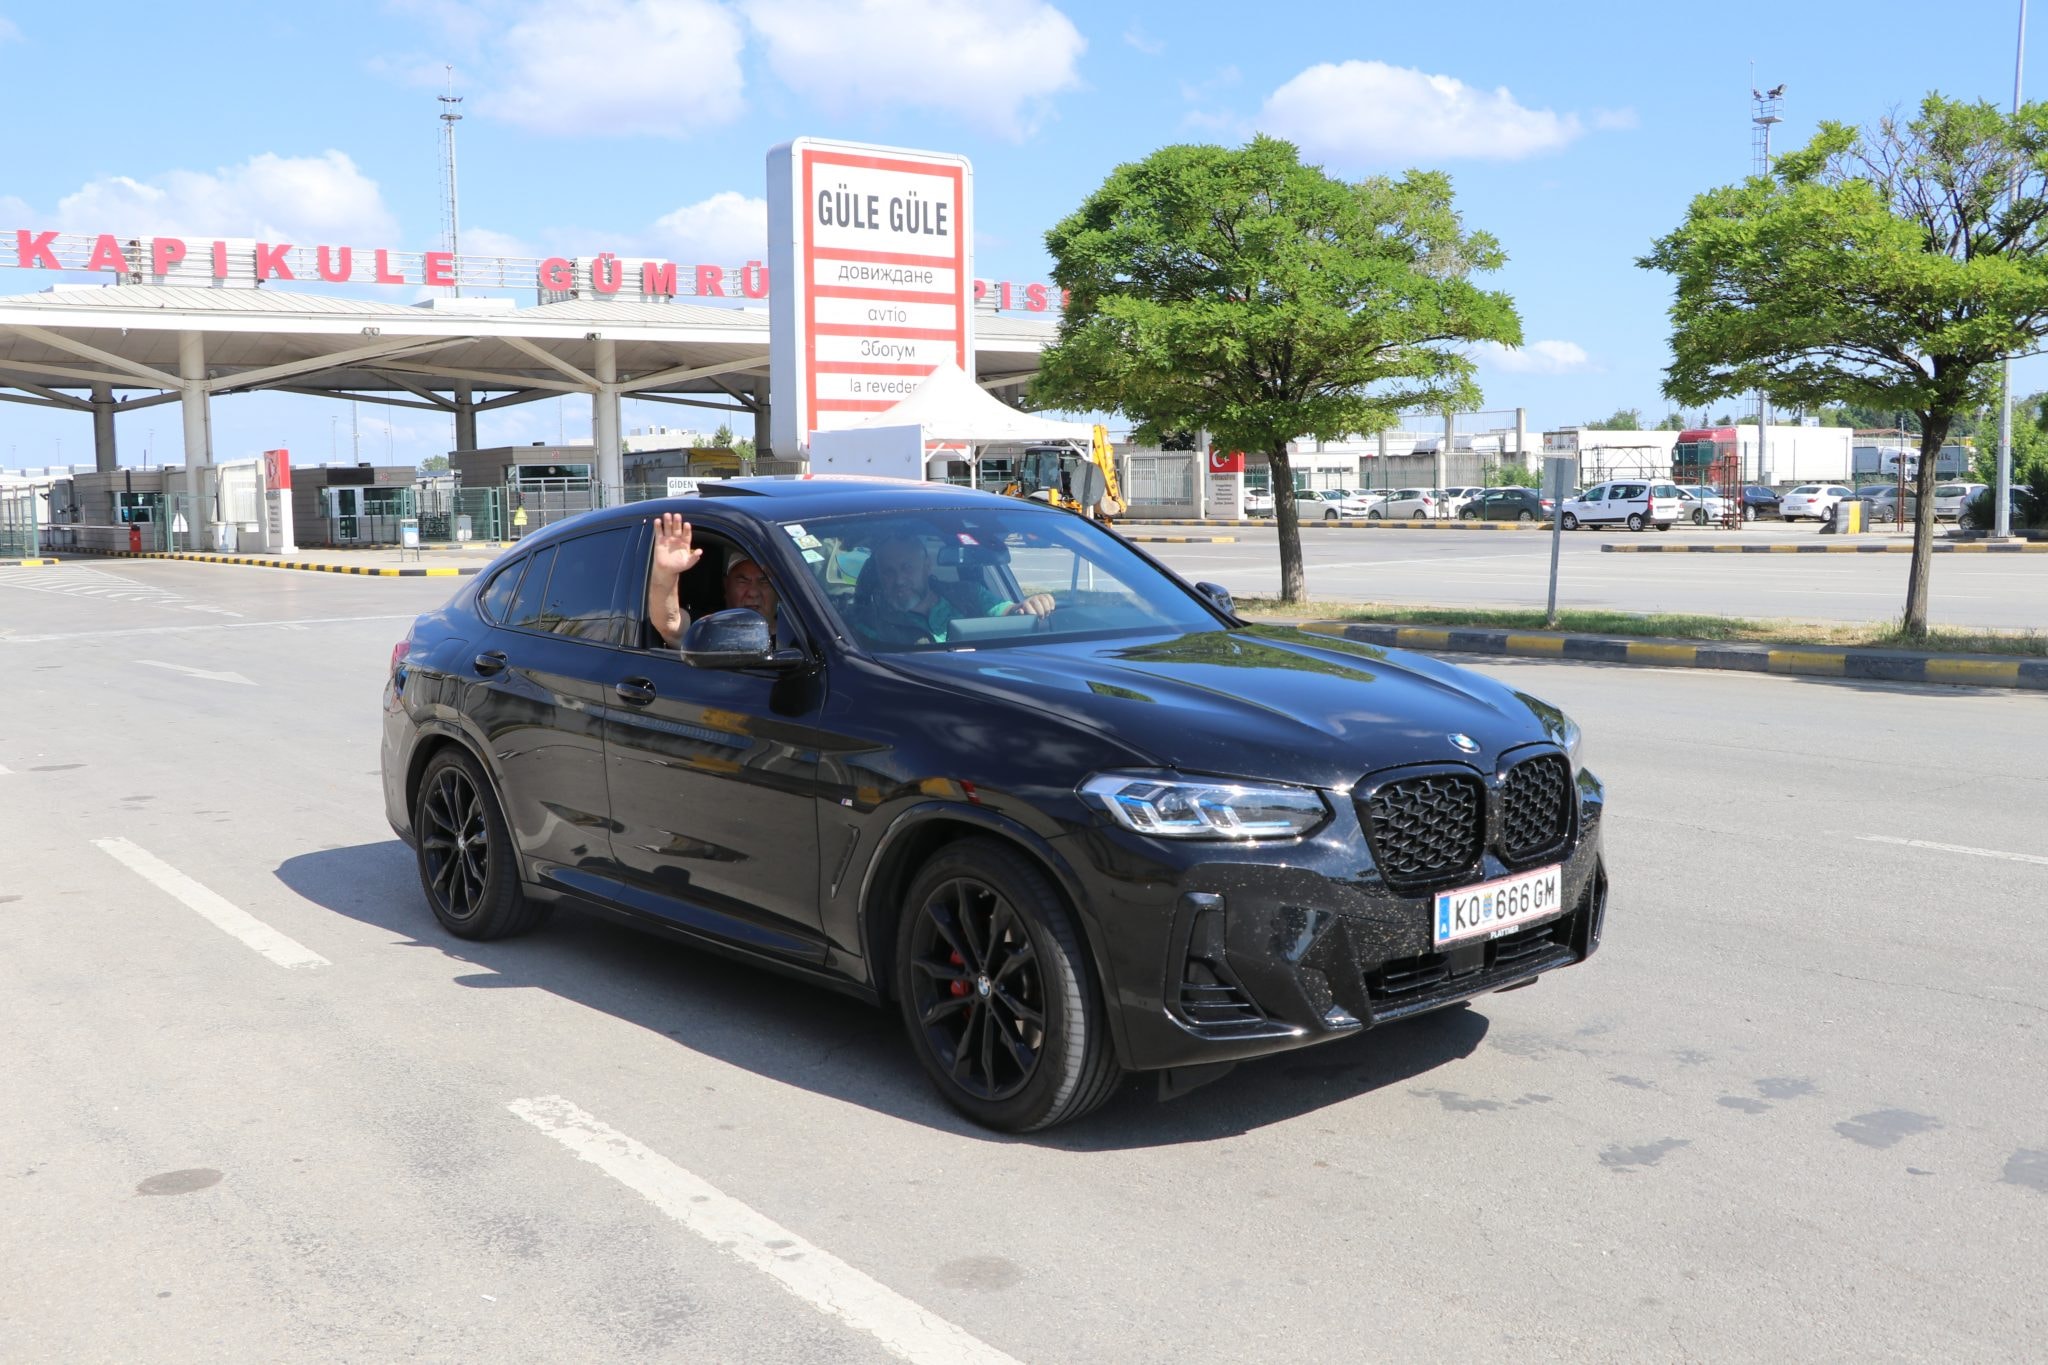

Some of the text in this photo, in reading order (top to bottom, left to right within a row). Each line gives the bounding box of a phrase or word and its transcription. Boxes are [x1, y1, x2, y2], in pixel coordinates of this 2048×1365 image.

[818, 183, 948, 236] GÜLE GÜLE
[17, 229, 456, 287] KAPIKULE
[539, 252, 770, 299] GÜMRÜ
[838, 265, 933, 285] довиждане
[861, 339, 916, 362] Збогум
[866, 379, 918, 394] reveder
[1455, 895, 1481, 931] KO
